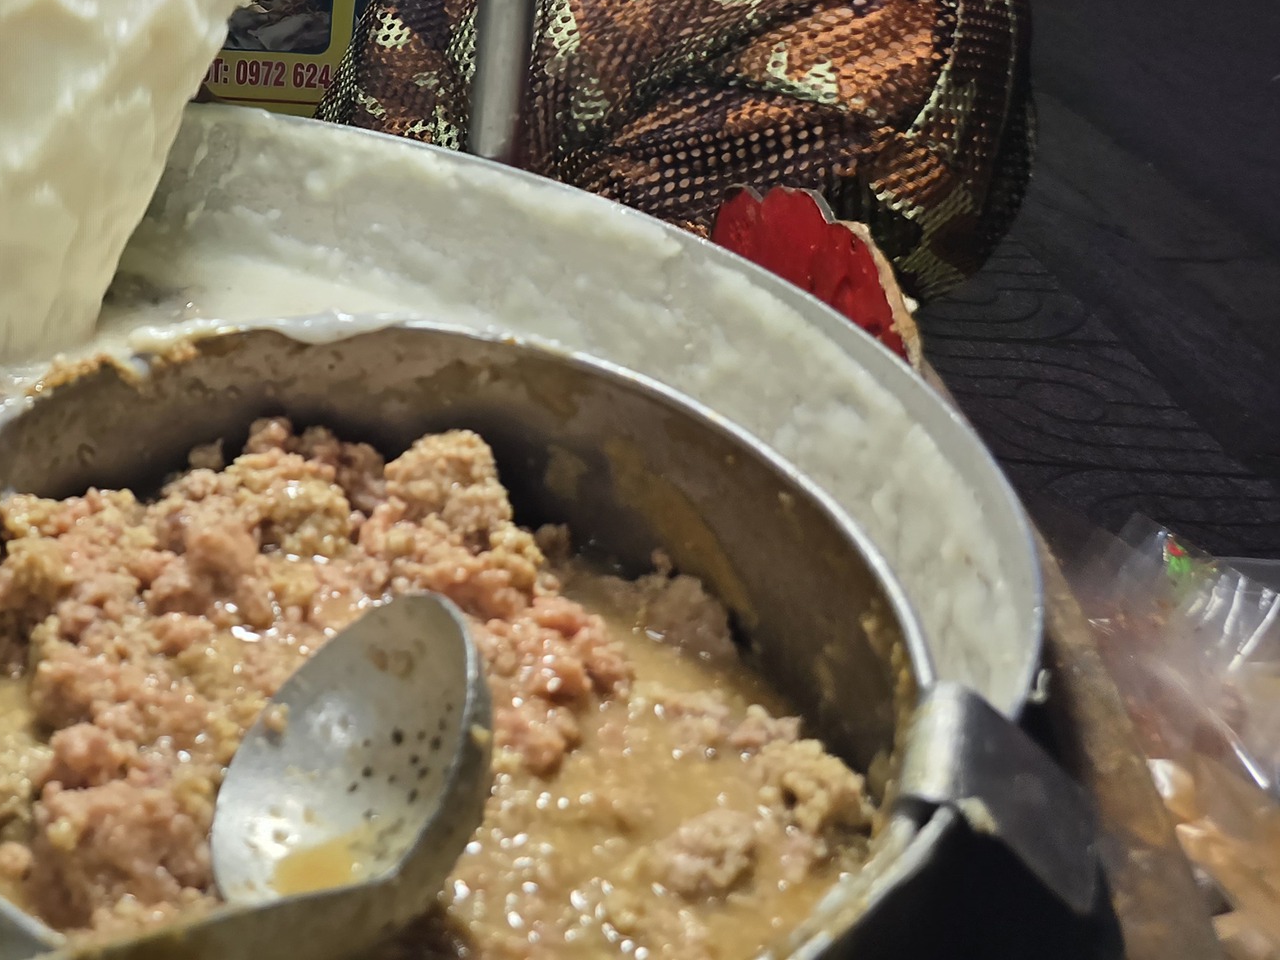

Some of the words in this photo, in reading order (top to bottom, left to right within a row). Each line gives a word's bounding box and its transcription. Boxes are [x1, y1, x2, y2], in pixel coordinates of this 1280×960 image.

[203, 59, 228, 84] T:
[236, 60, 286, 87] 0972
[293, 63, 332, 89] 624
